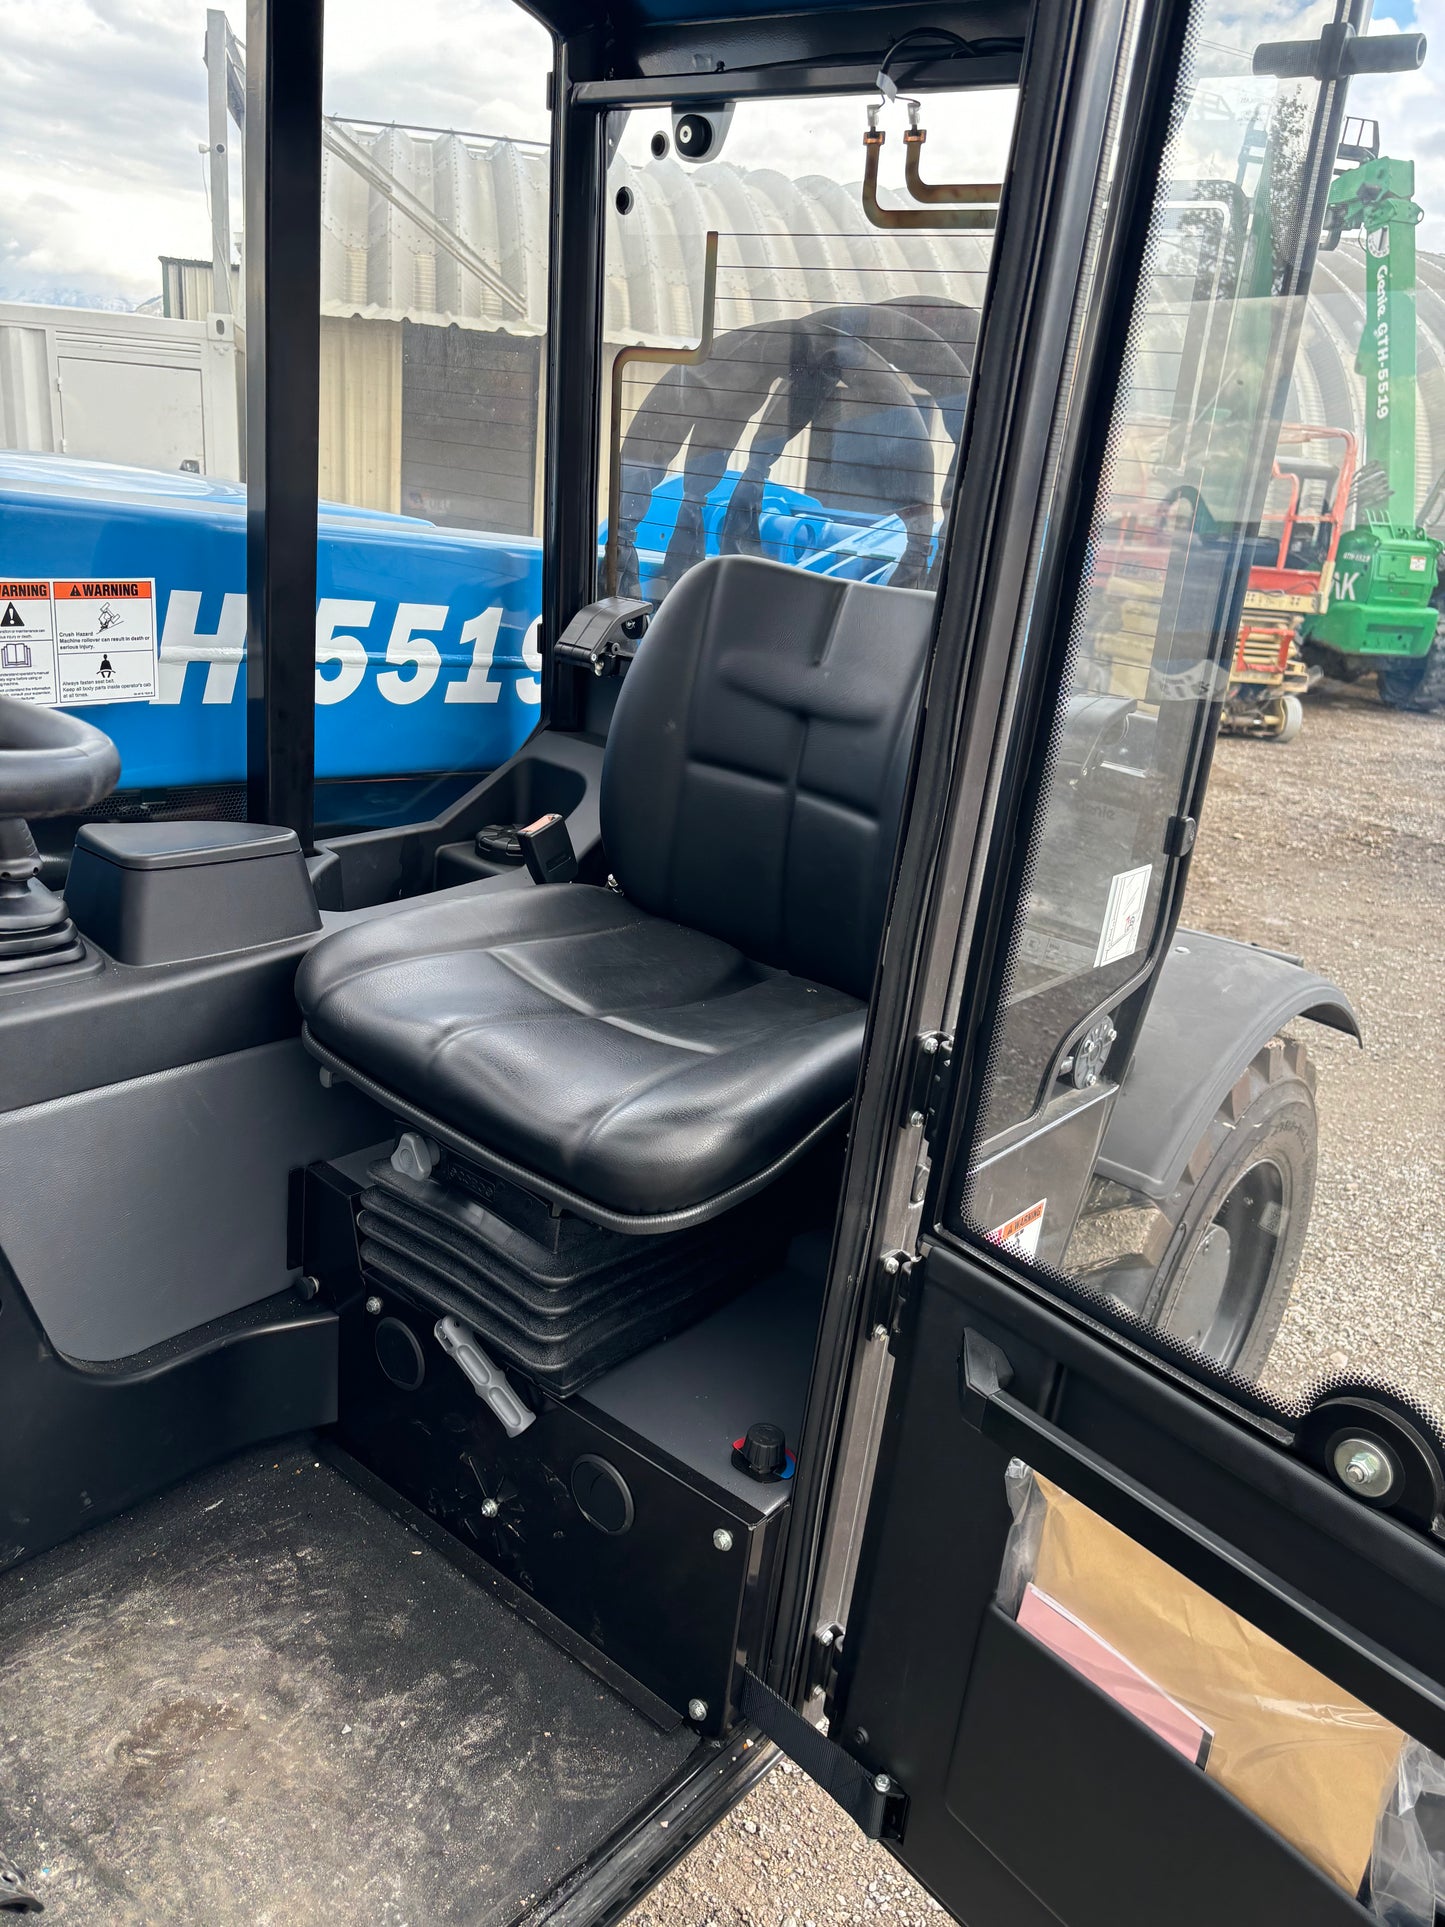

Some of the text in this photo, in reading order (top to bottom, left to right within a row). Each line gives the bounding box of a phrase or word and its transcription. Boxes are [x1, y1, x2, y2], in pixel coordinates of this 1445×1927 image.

[1376, 322, 1389, 419] GTH-5519
[0, 584, 47, 597] ARNING
[82, 584, 138, 597] WARNING
